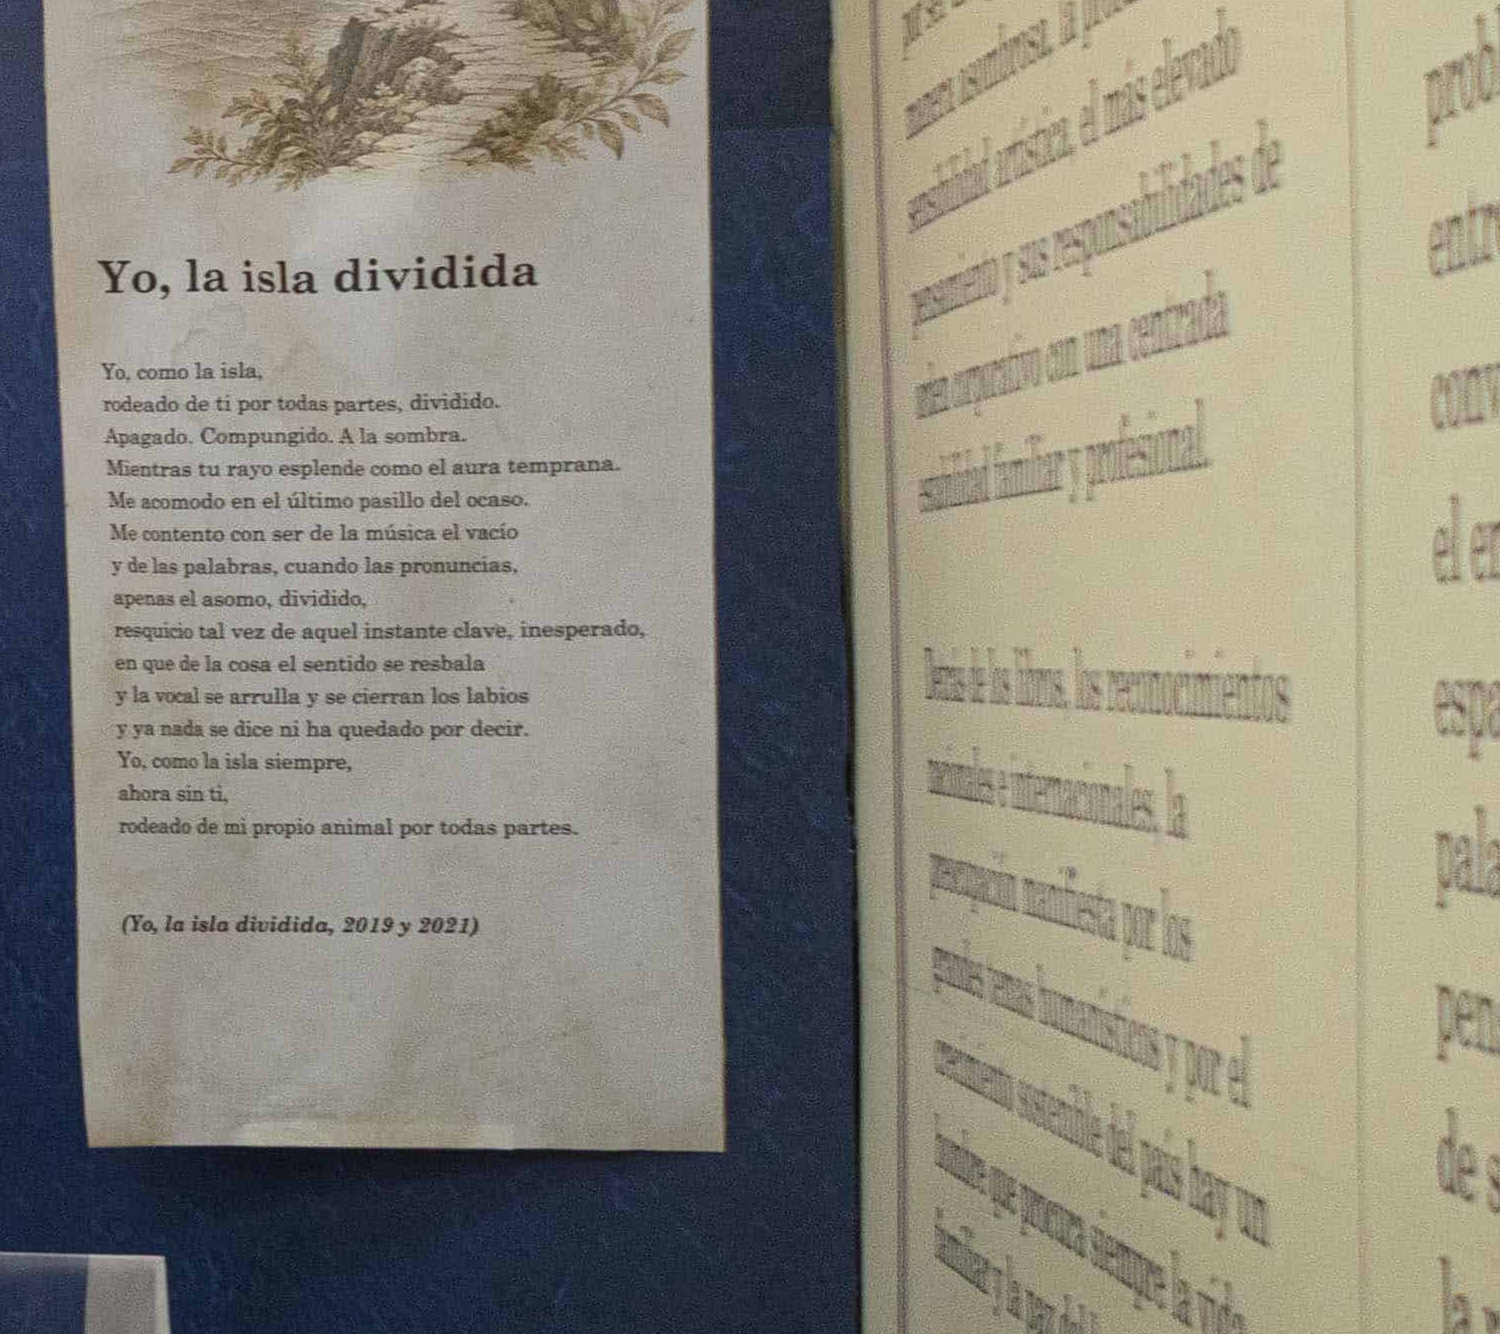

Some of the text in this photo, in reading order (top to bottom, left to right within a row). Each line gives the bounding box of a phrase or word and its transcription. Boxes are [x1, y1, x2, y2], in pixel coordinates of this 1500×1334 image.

[96, 252, 539, 301] Yo, la isla dividida
[100, 360, 264, 385] Yo, como la isla,
[1105, 647, 1292, 725] reconocimientos
[120, 912, 480, 939] (Yo, la isla dividida, 2019 y 2021)
[1436, 1104, 1479, 1204] de
